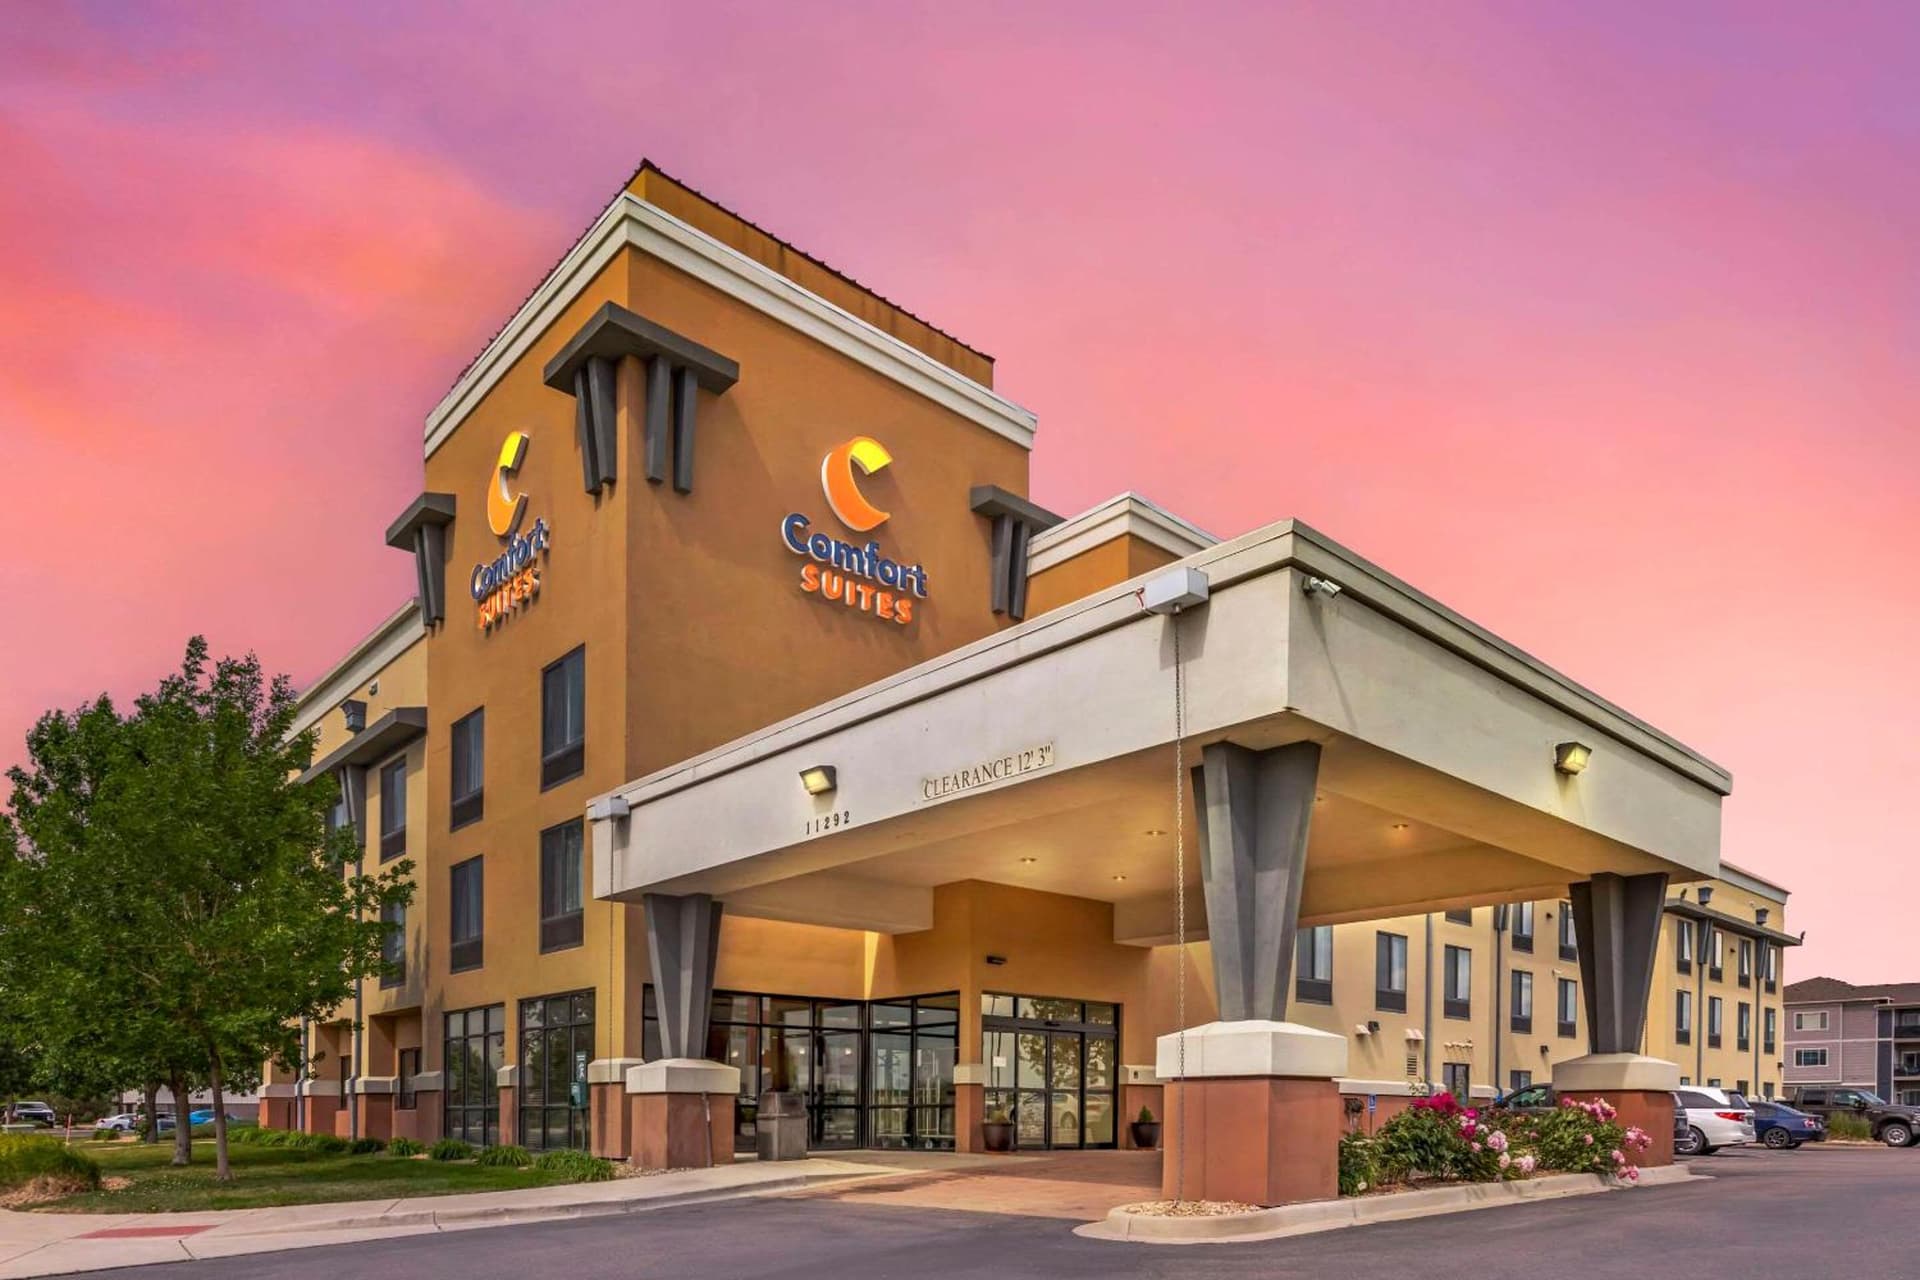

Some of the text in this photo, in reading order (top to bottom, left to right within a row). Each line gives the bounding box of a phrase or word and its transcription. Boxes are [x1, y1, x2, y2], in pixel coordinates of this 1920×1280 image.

[470, 518, 548, 601] Comfort
[781, 512, 928, 598] Comfort
[479, 568, 541, 629] SUITES
[801, 563, 913, 625] SUITES
[924, 757, 1013, 799] CLEARANCE
[805, 810, 851, 835] 11292
